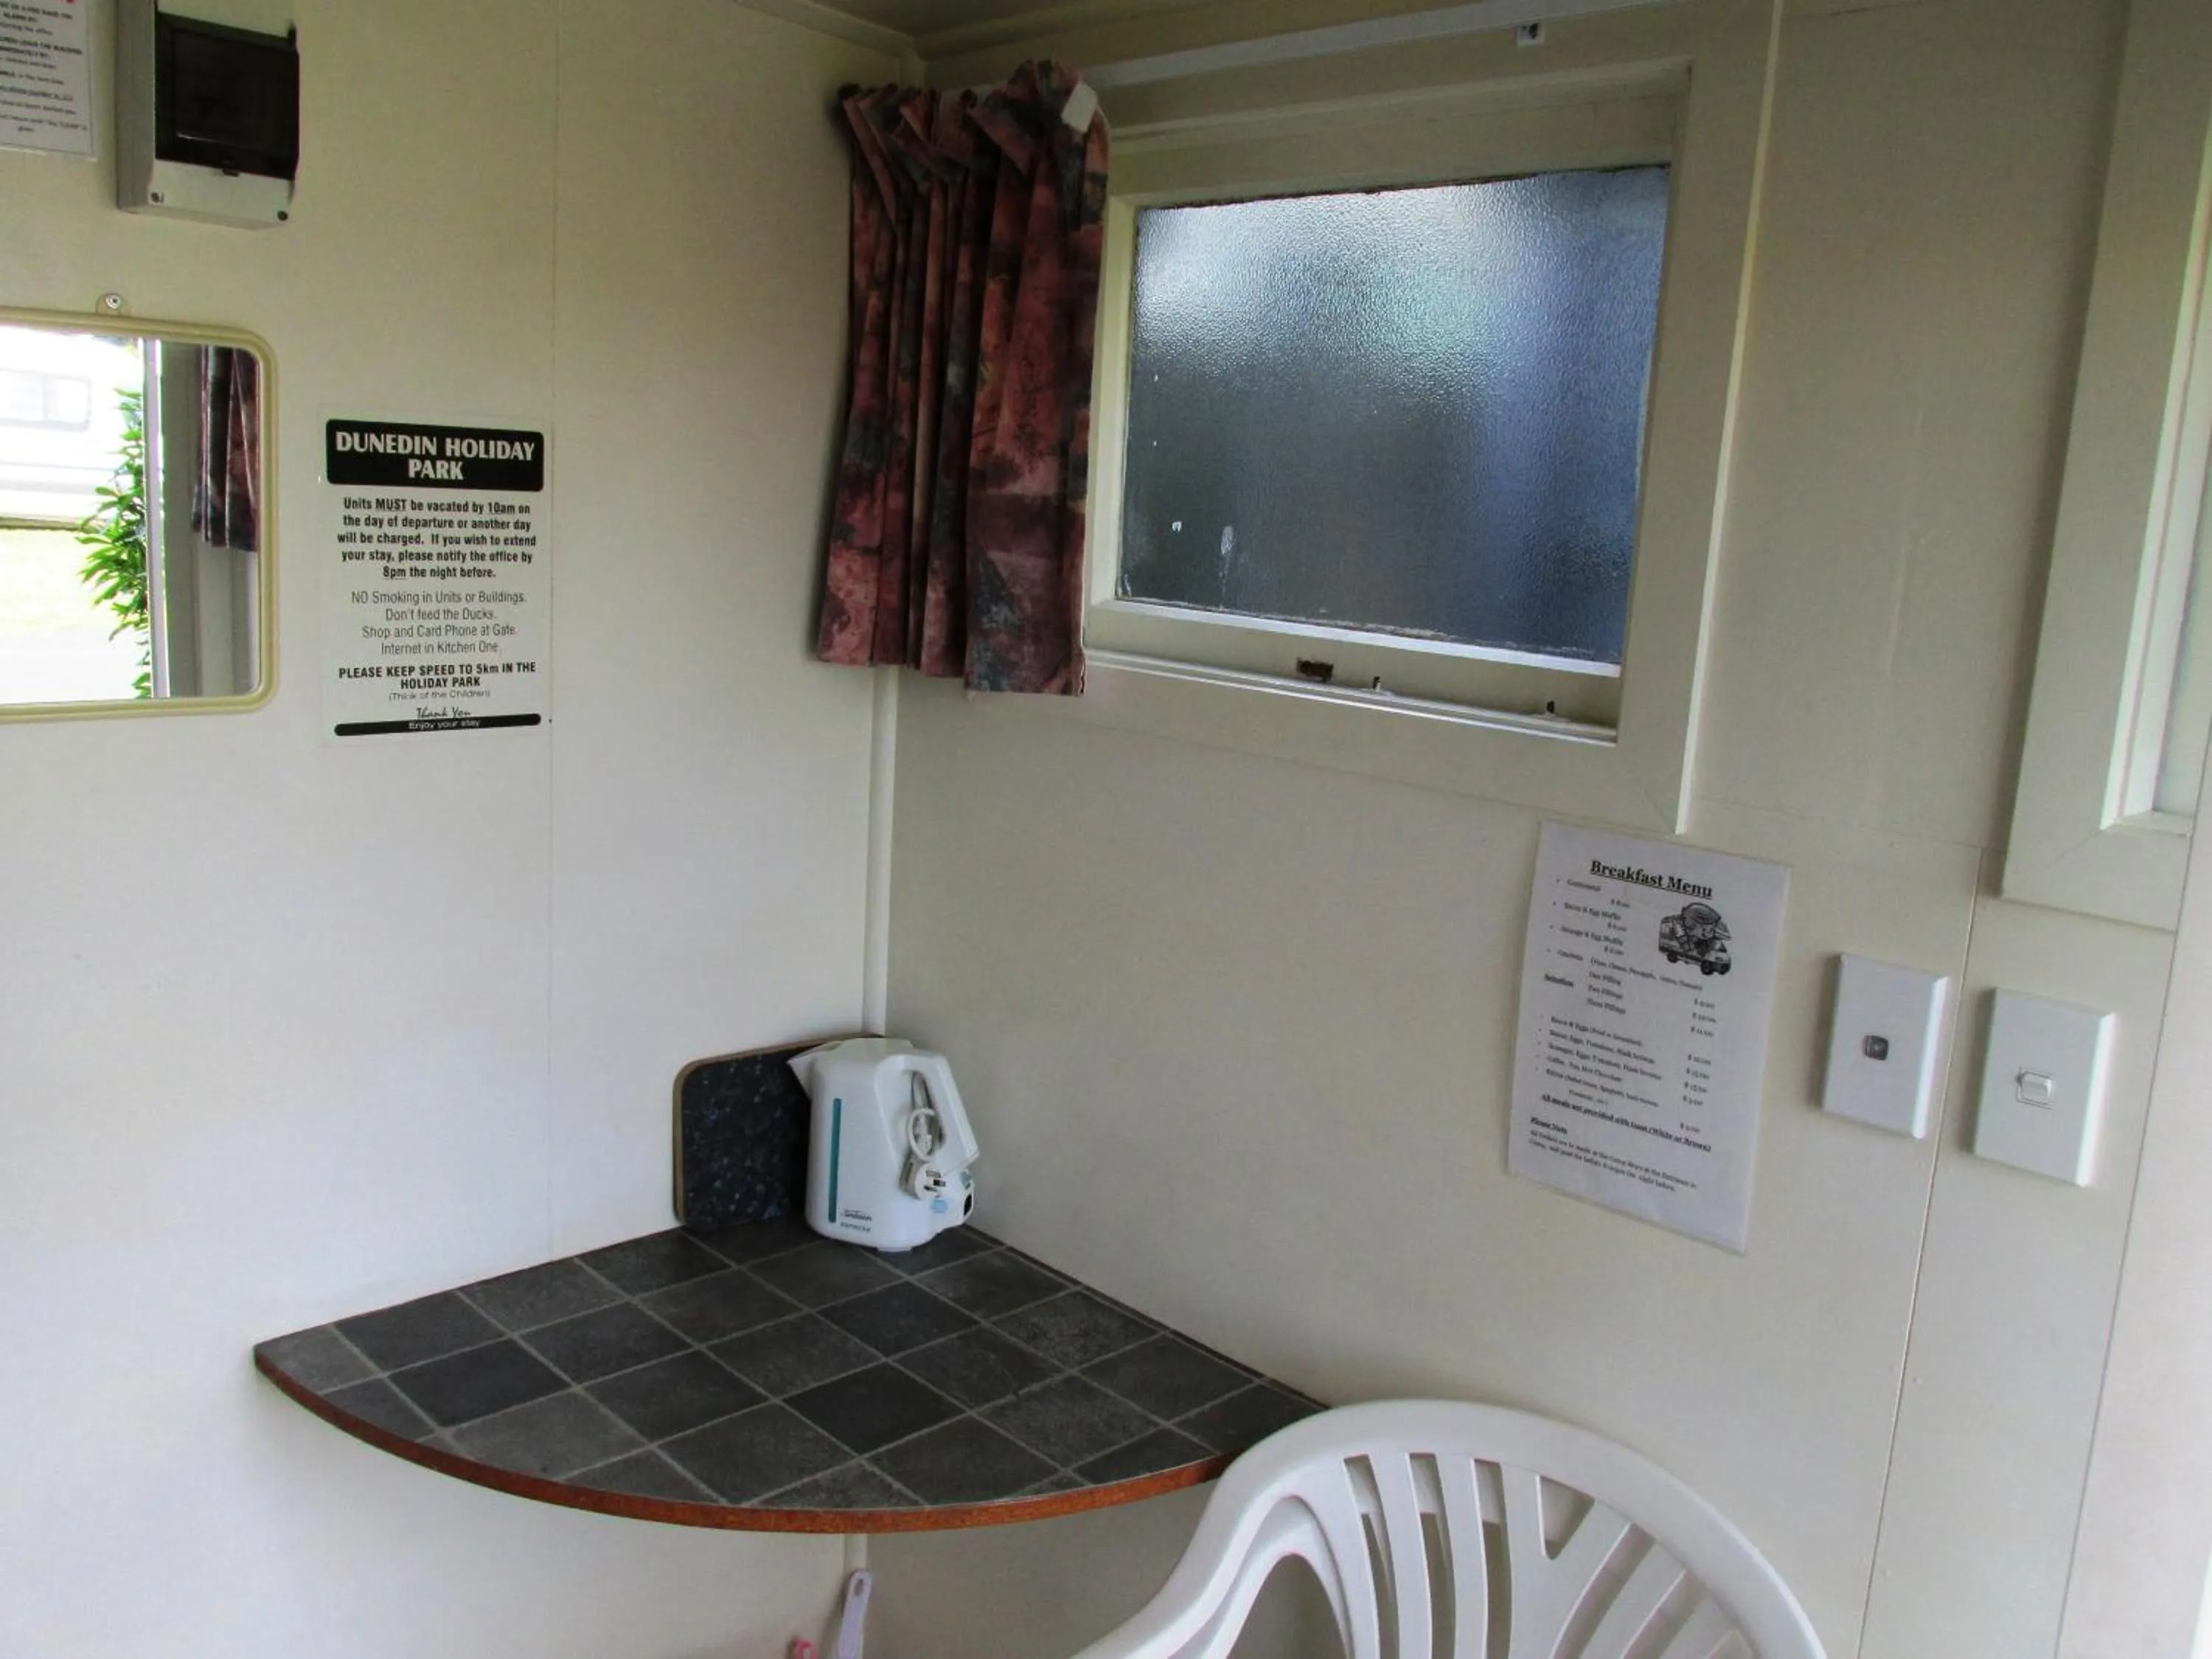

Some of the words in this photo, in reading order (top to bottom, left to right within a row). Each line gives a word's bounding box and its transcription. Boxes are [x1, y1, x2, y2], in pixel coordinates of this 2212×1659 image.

[336, 431, 437, 456] DUNEDIN
[445, 437, 535, 461] HOLIDAY
[408, 459, 464, 480] PARK
[344, 498, 372, 509] Units
[375, 498, 407, 512] MUST
[411, 500, 423, 511] be
[428, 501, 469, 512] vacated
[473, 502, 484, 515] by
[487, 502, 515, 514] 10am
[518, 505, 530, 514] on
[343, 515, 361, 527] the
[364, 515, 383, 529] day
[387, 516, 399, 527] of
[402, 516, 454, 530] departure
[457, 519, 467, 529] or
[471, 518, 510, 529] another
[513, 519, 531, 532] day
[338, 532, 356, 543] will
[360, 533, 373, 544] be
[377, 533, 425, 546] charged.
[431, 533, 440, 545] If
[442, 535, 461, 547] you
[464, 535, 487, 546] wish
[490, 535, 501, 546] to
[504, 535, 536, 546] extend
[341, 551, 366, 562] your
[398, 551, 433, 563] please
[437, 550, 467, 563] notify
[470, 551, 486, 561] the
[489, 551, 518, 562] office
[521, 552, 533, 564] by
[383, 566, 406, 579] 8pm
[409, 566, 426, 577] the
[430, 566, 457, 580] night
[459, 566, 496, 577] before.
[352, 591, 368, 604] NO
[372, 591, 420, 605] Smoking
[422, 591, 433, 603] in
[436, 591, 462, 603] Units
[465, 593, 475, 602] or
[479, 591, 527, 605] Buildings.
[386, 608, 414, 621] Don't
[417, 608, 440, 620] feed
[443, 608, 459, 620] the
[462, 608, 497, 620] Ducks.
[362, 625, 390, 639] Shop
[394, 626, 414, 638] and
[417, 625, 442, 637] Card
[445, 625, 477, 637] Phone
[481, 625, 490, 636] at
[381, 642, 421, 655] Internet
[425, 642, 434, 654] in
[437, 641, 476, 654] Kitchen
[339, 666, 382, 678] PLEASE
[386, 665, 415, 678] KEEP
[420, 664, 455, 676] SPEED
[459, 664, 473, 675] TO
[476, 663, 499, 674] 5km
[502, 662, 512, 673] IN
[516, 661, 536, 673] THE
[400, 677, 448, 689] HOLIDAY
[452, 676, 480, 687] PARK
[417, 707, 448, 719] Thank
[437, 720, 458, 729] your
[1590, 860, 1663, 889] Breakfast
[1666, 876, 1712, 900] Menu
